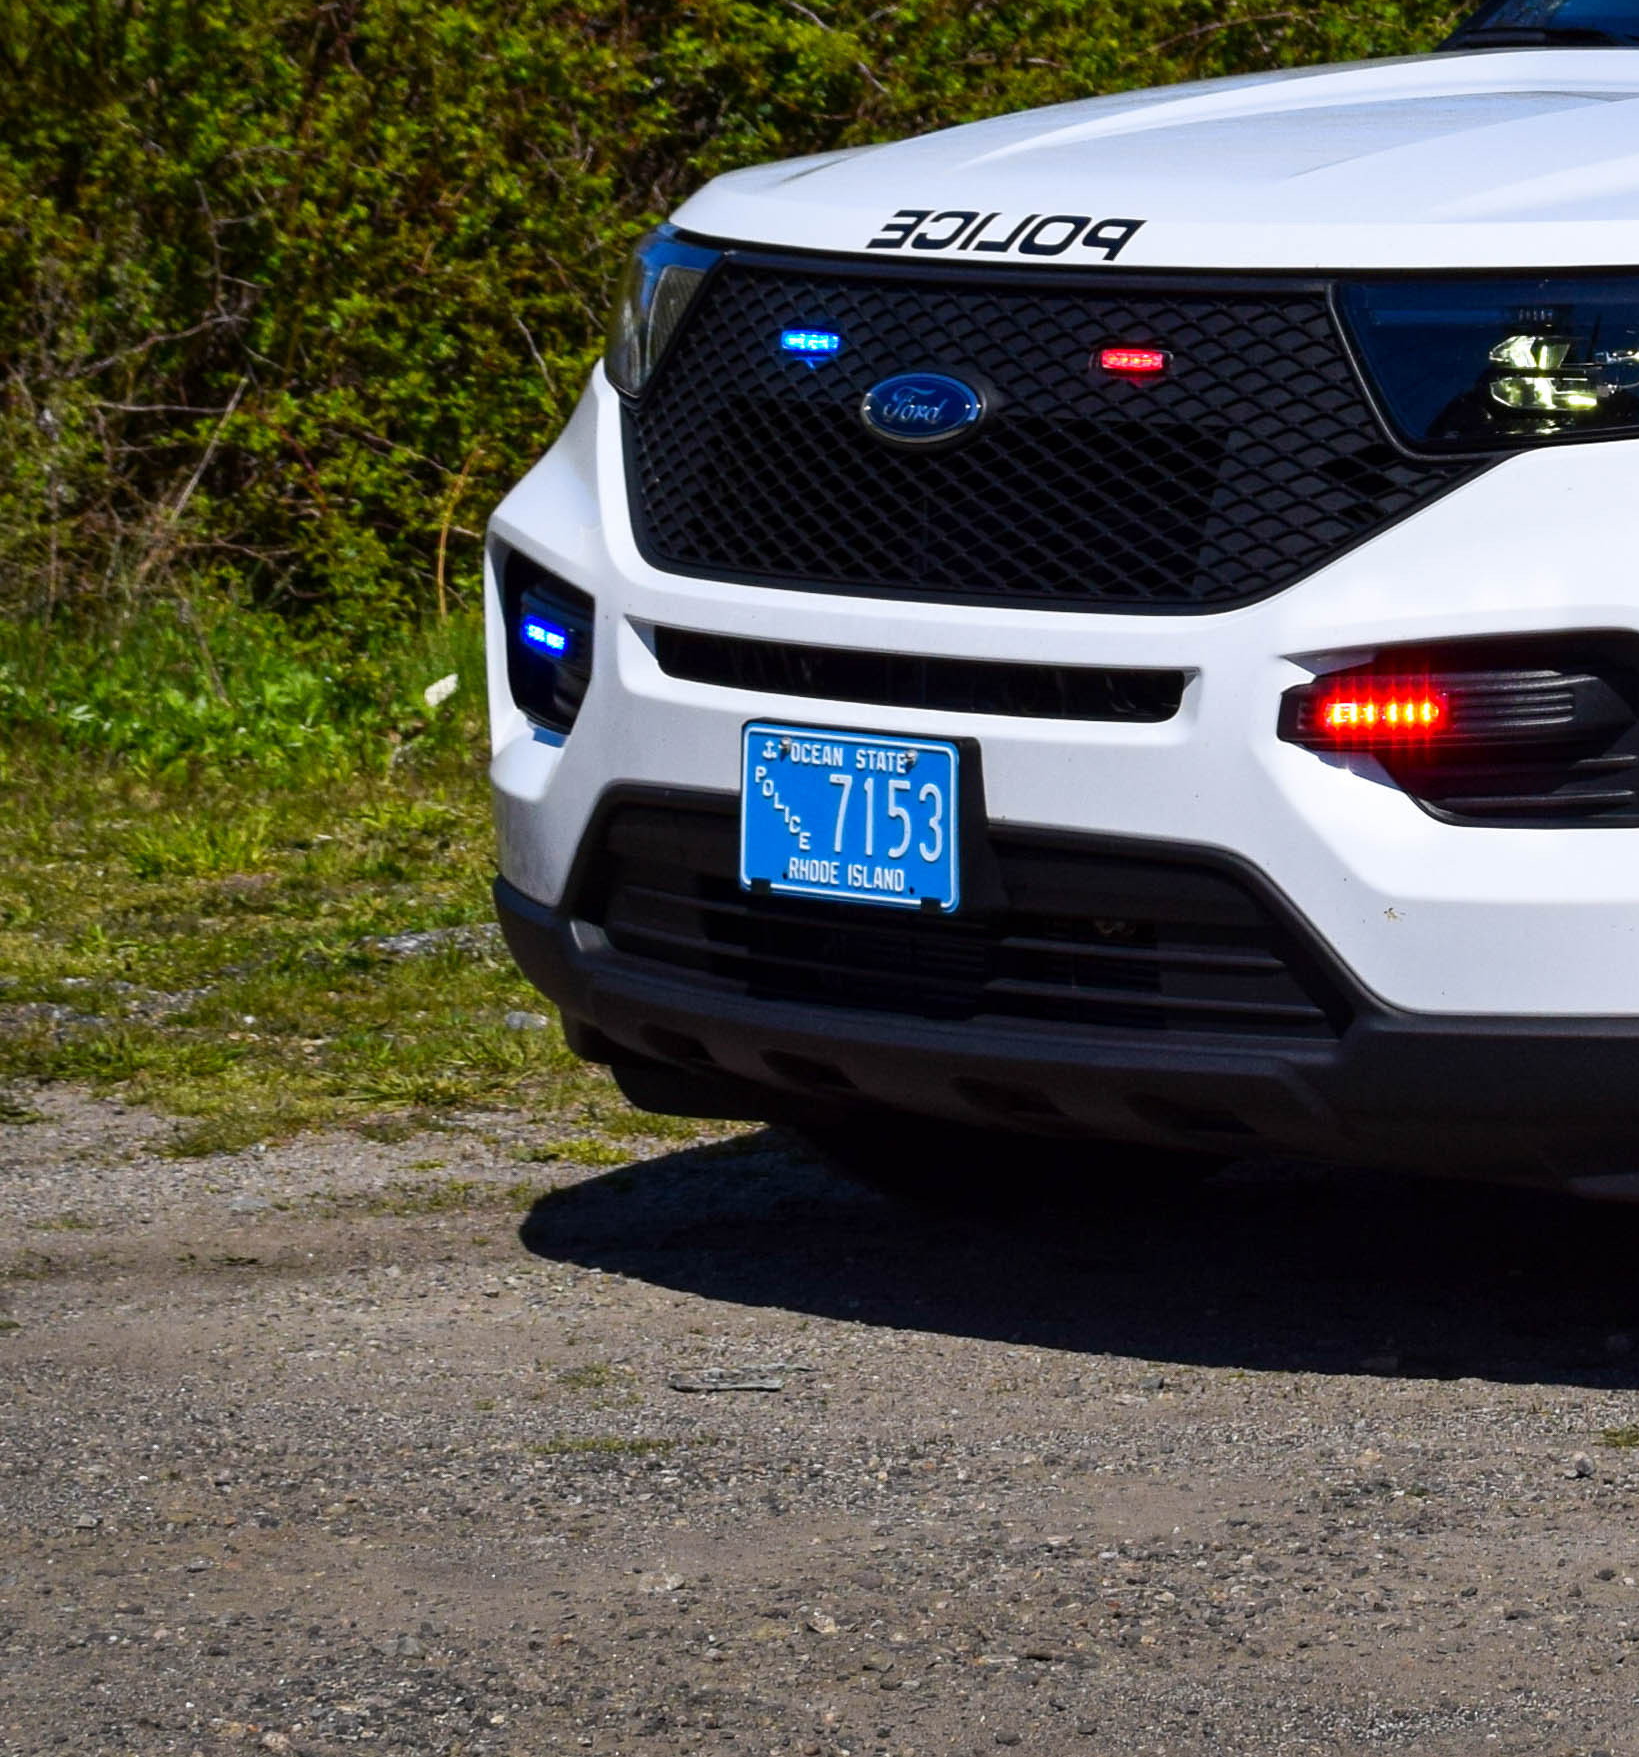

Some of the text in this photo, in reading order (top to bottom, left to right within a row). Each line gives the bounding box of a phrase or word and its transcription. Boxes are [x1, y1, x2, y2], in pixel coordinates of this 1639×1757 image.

[882, 385, 949, 425] Ford
[790, 741, 908, 774] OCEAN STATE
[754, 765, 812, 851] POLICE
[829, 773, 944, 862] 7153
[788, 856, 905, 893] RHODE ISLAND
